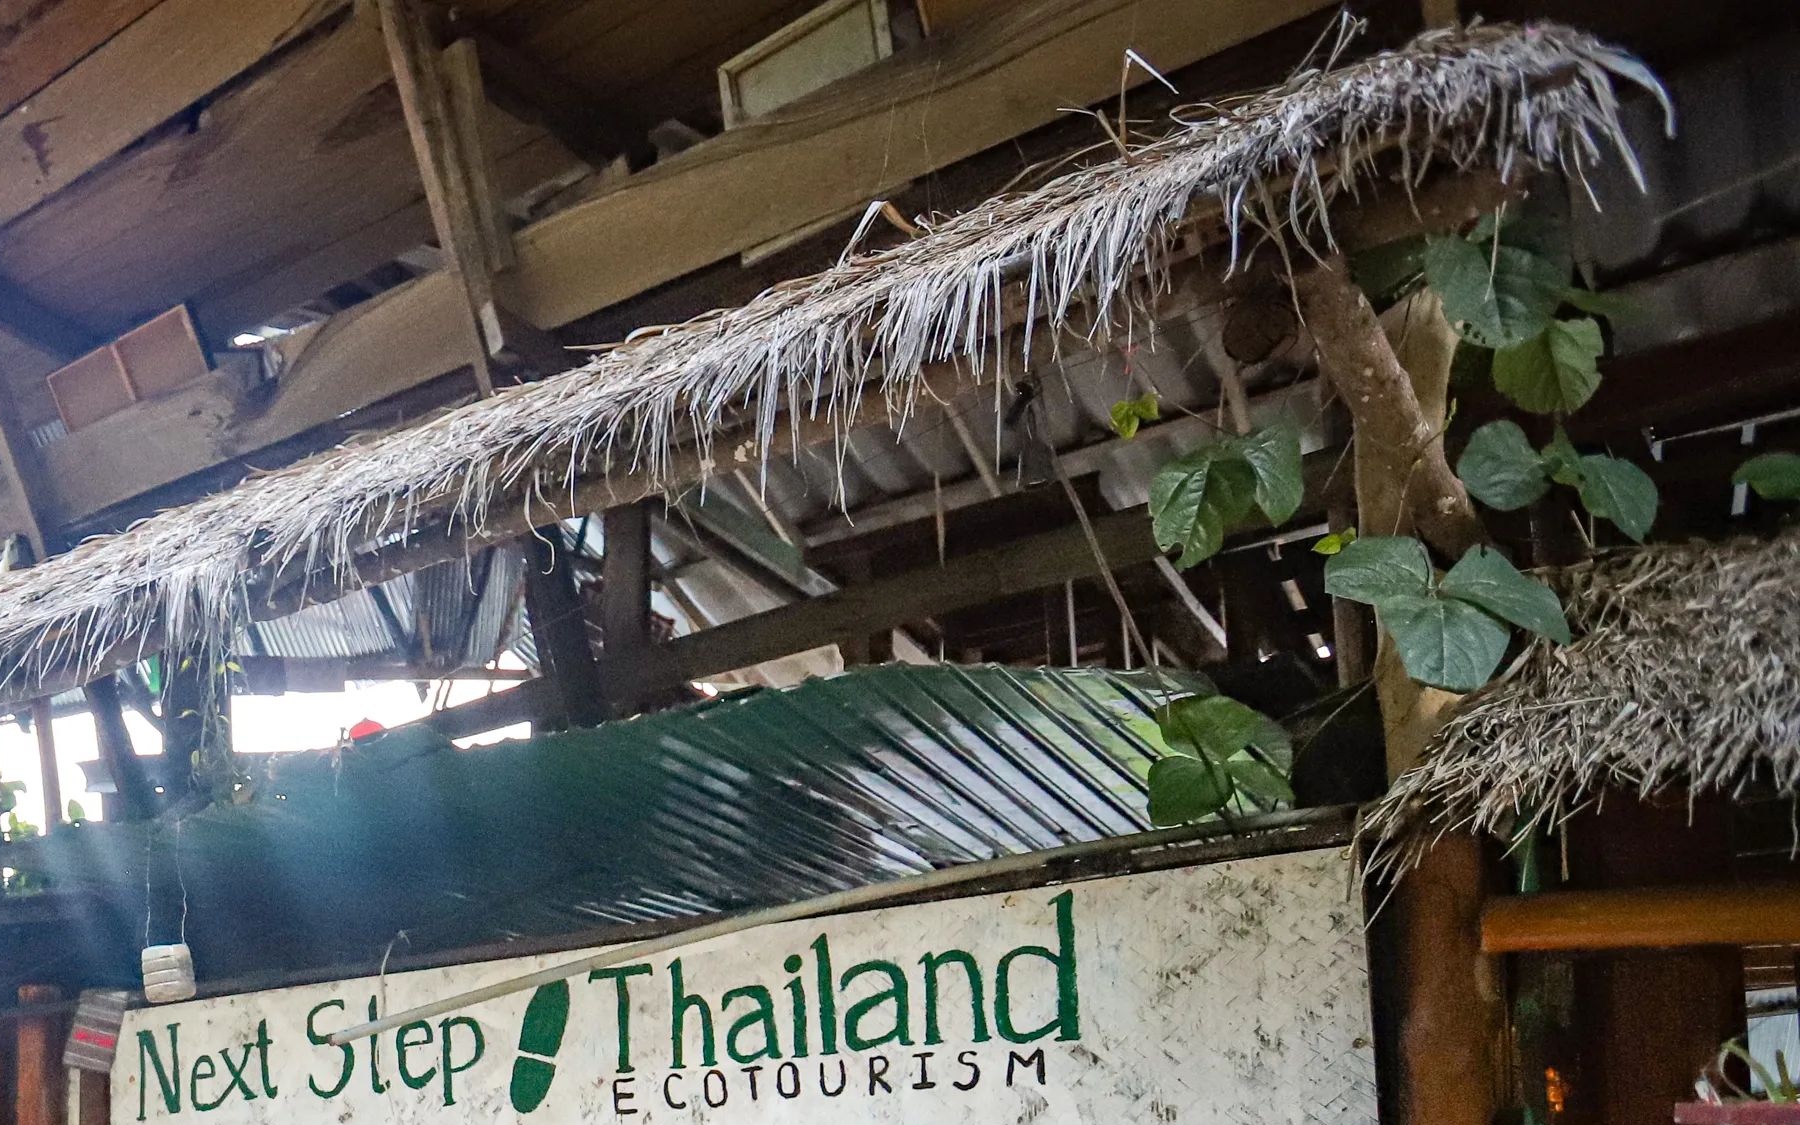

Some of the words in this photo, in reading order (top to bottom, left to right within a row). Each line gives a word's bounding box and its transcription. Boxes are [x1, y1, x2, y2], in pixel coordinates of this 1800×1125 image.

[135, 1020, 278, 1121] Next
[306, 994, 486, 1107] Step
[587, 889, 1082, 1073] Thailand
[612, 1046, 1047, 1115] ECOTOURISM
